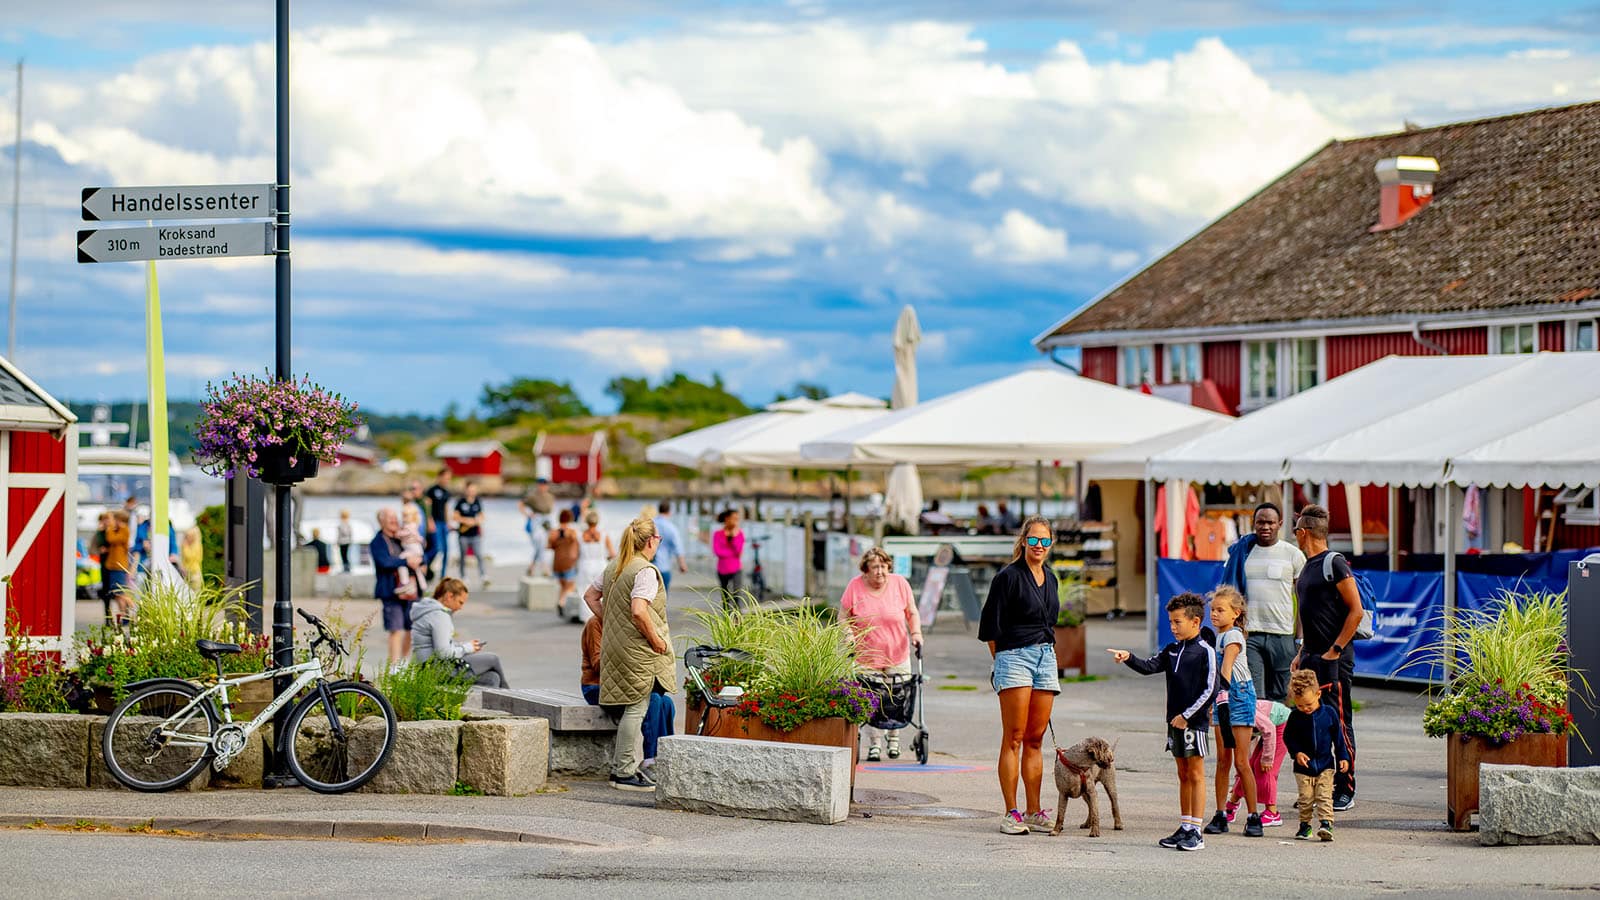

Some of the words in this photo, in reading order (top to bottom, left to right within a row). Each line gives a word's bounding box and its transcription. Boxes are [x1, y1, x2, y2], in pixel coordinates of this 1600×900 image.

[112, 193, 259, 212] Handelssenter
[159, 227, 216, 241] Kroksand
[107, 239, 128, 251] 310
[159, 243, 228, 256] badestrand
[1183, 727, 1195, 744] 6
